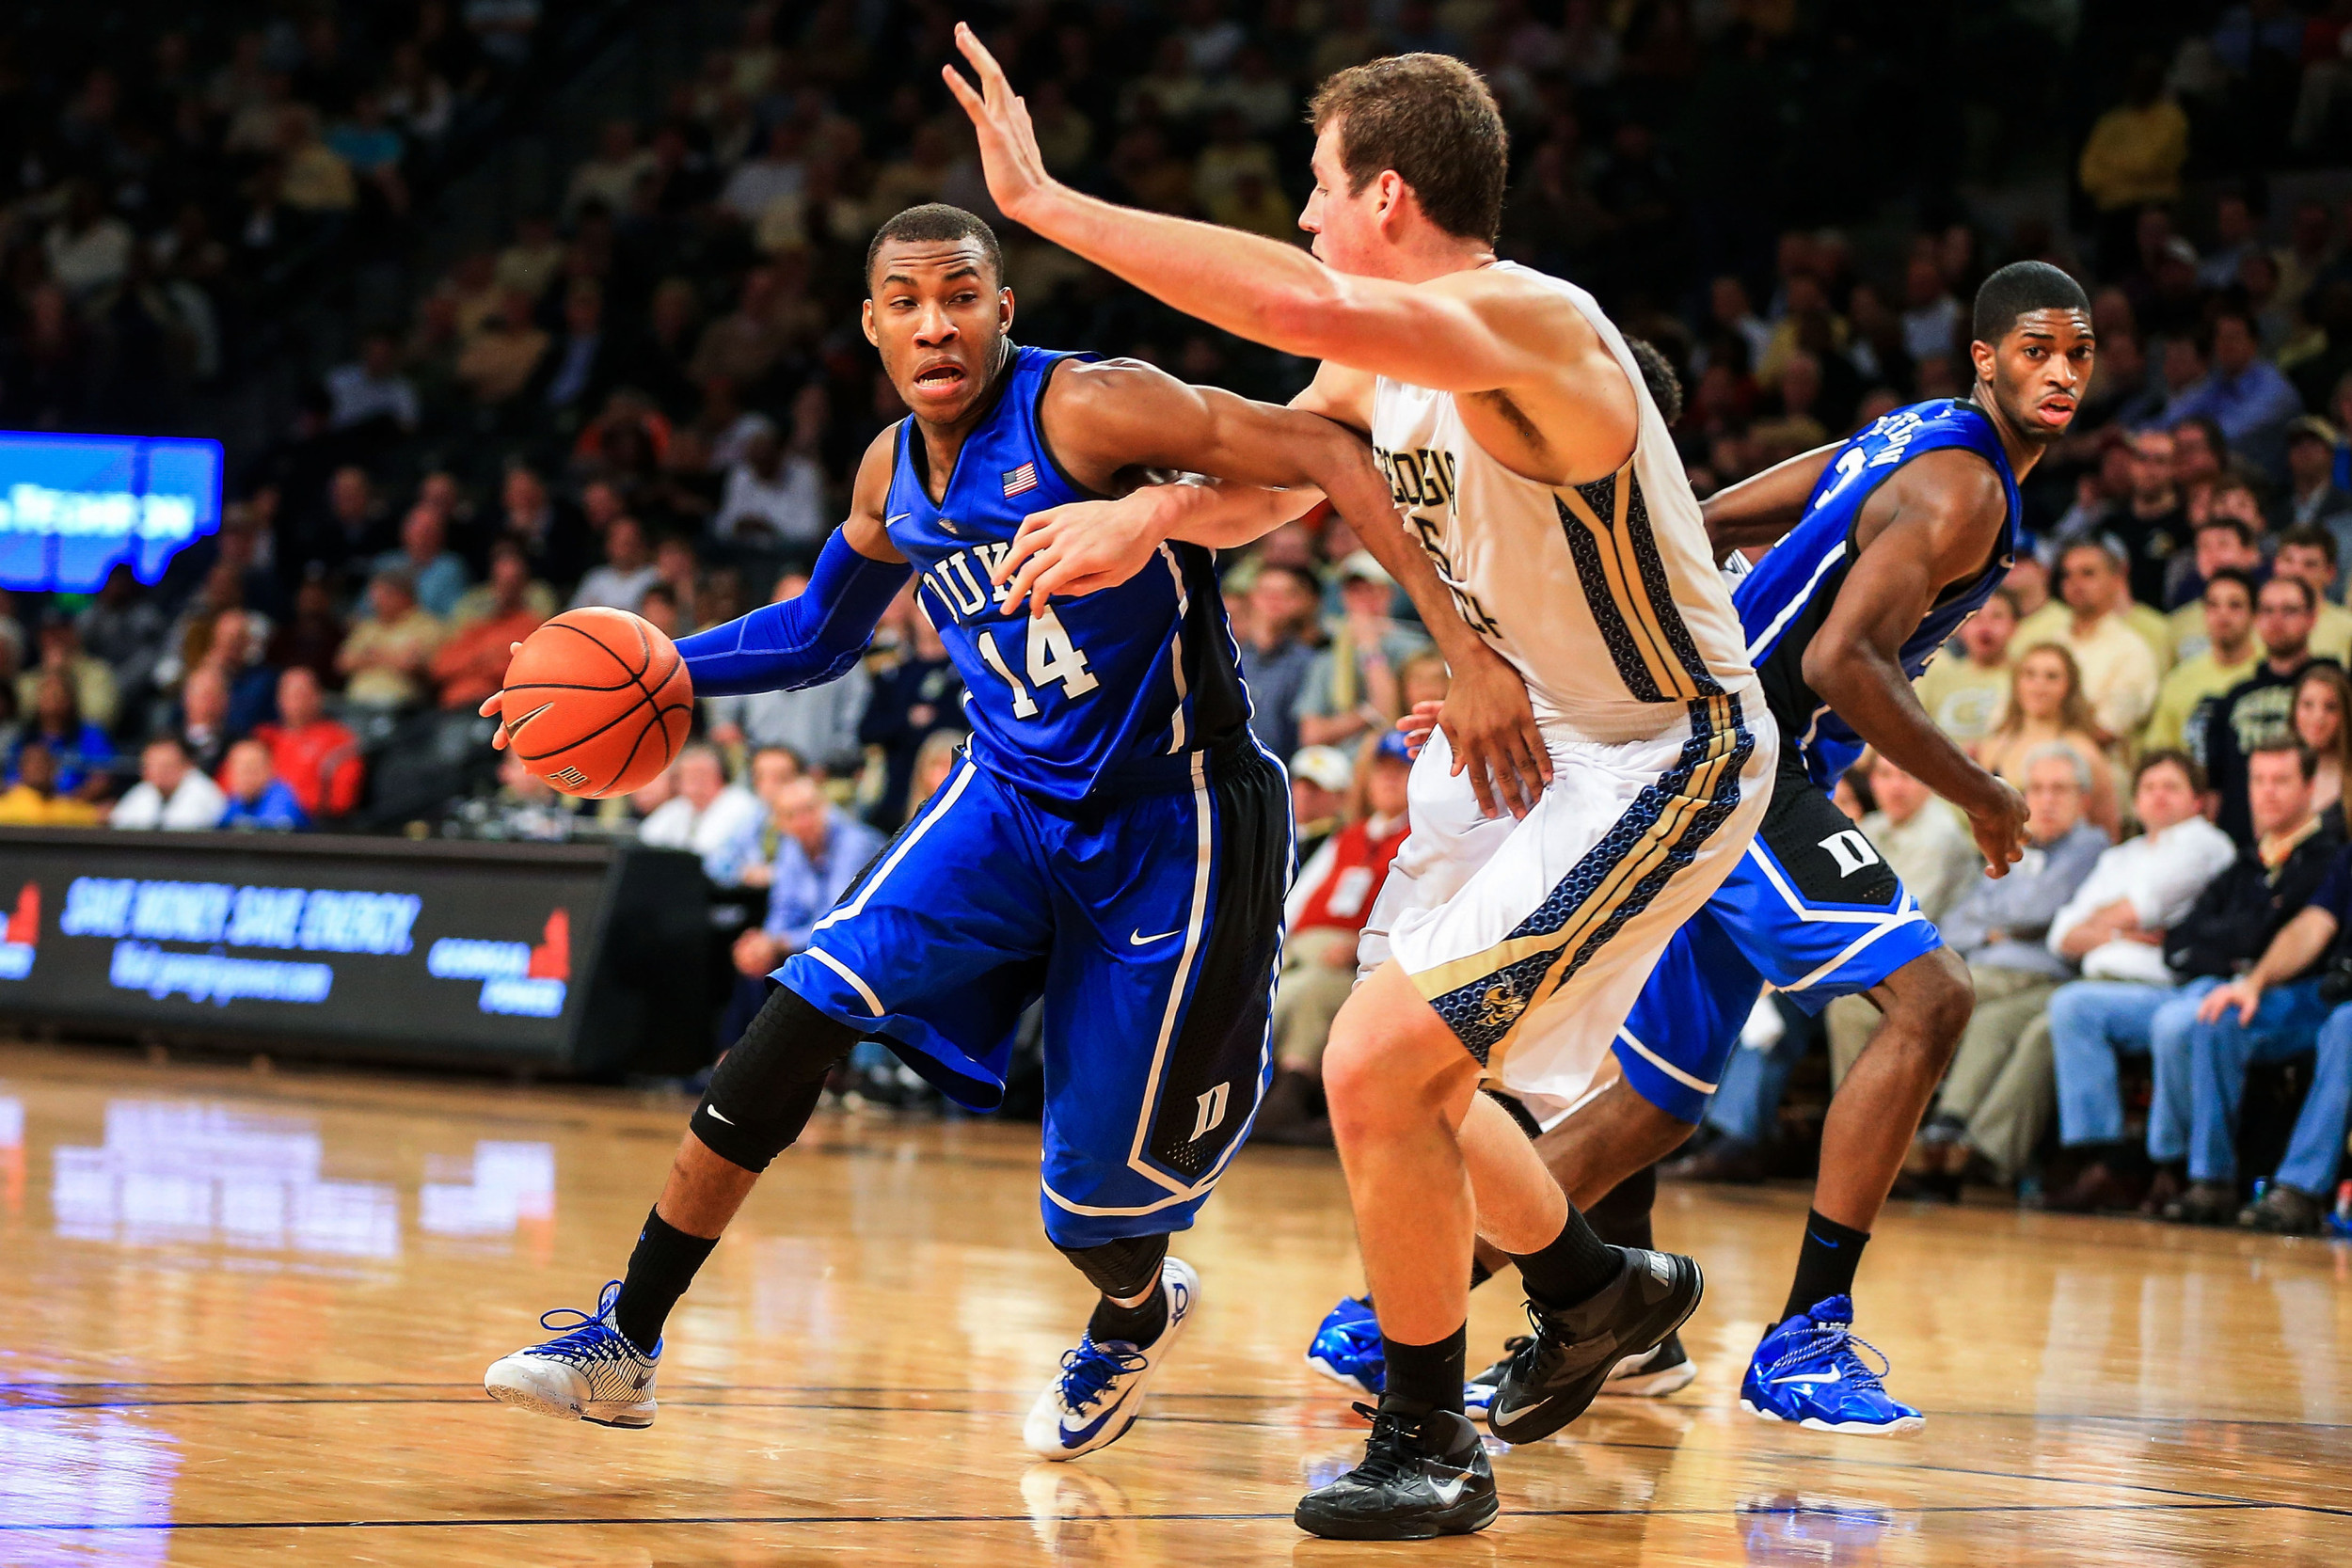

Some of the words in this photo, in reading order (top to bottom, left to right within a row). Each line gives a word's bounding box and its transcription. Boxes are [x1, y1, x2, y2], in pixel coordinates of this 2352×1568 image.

[921, 541, 1040, 625] DUK
[977, 603, 1100, 720] 14
[1817, 829, 1880, 879] D
[1188, 1082, 1231, 1143] D
